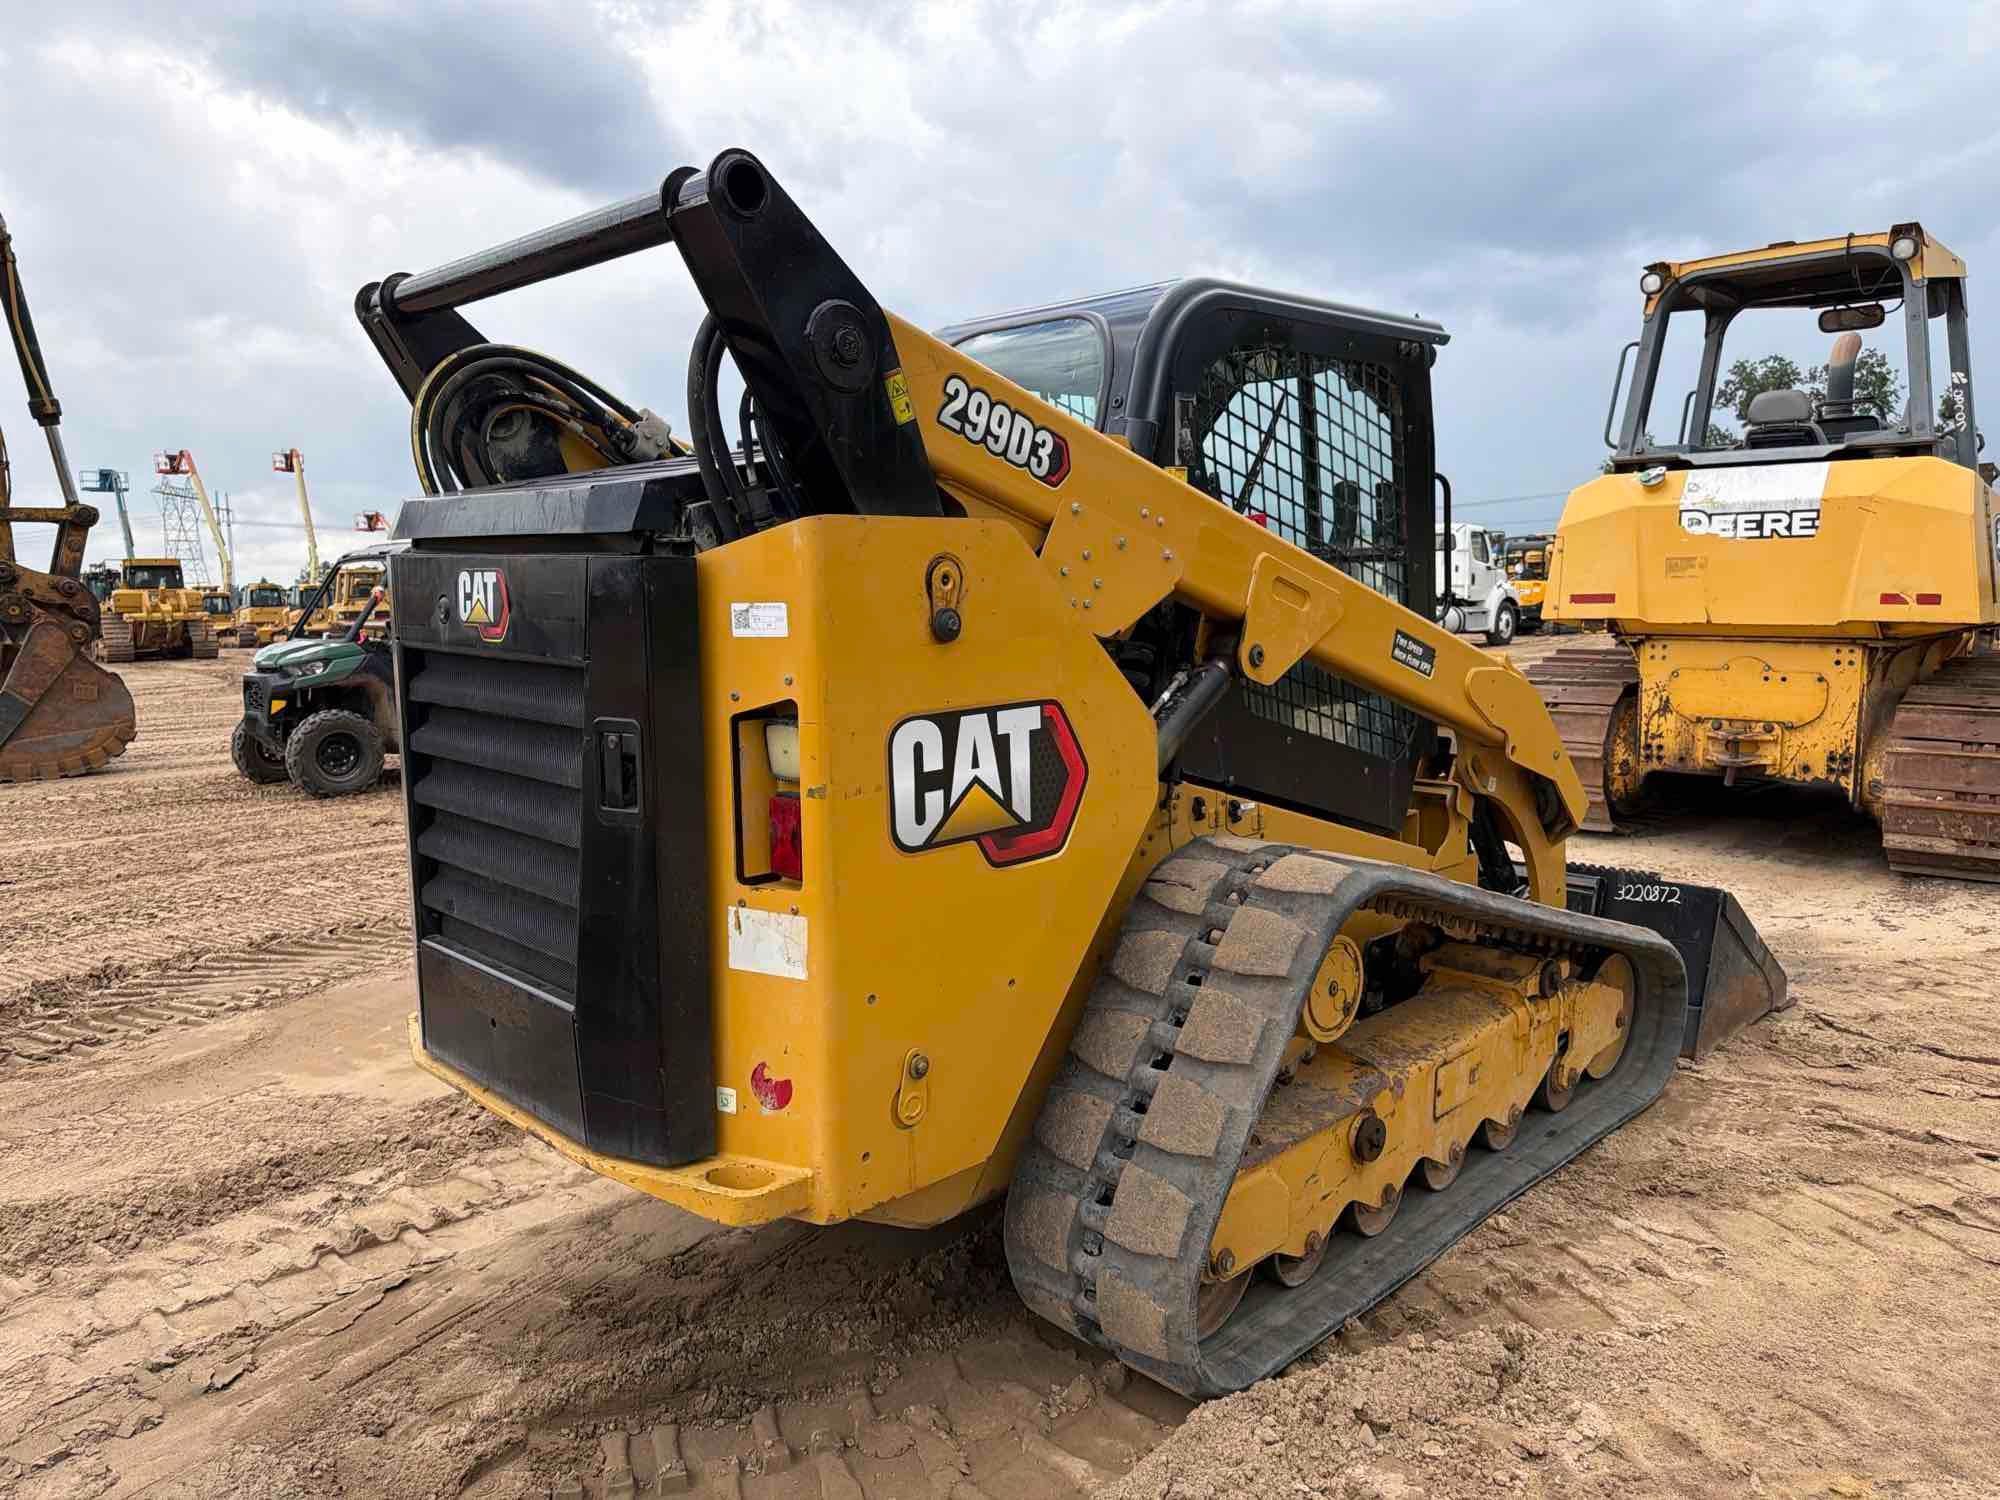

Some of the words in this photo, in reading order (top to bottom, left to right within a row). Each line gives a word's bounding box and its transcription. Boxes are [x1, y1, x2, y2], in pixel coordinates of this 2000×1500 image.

[938, 376, 1054, 479] 299D3
[1679, 509, 1820, 539] DEERE
[459, 571, 497, 623] CAT
[892, 705, 1042, 847] CAT
[1613, 884, 1682, 905] 3220872
